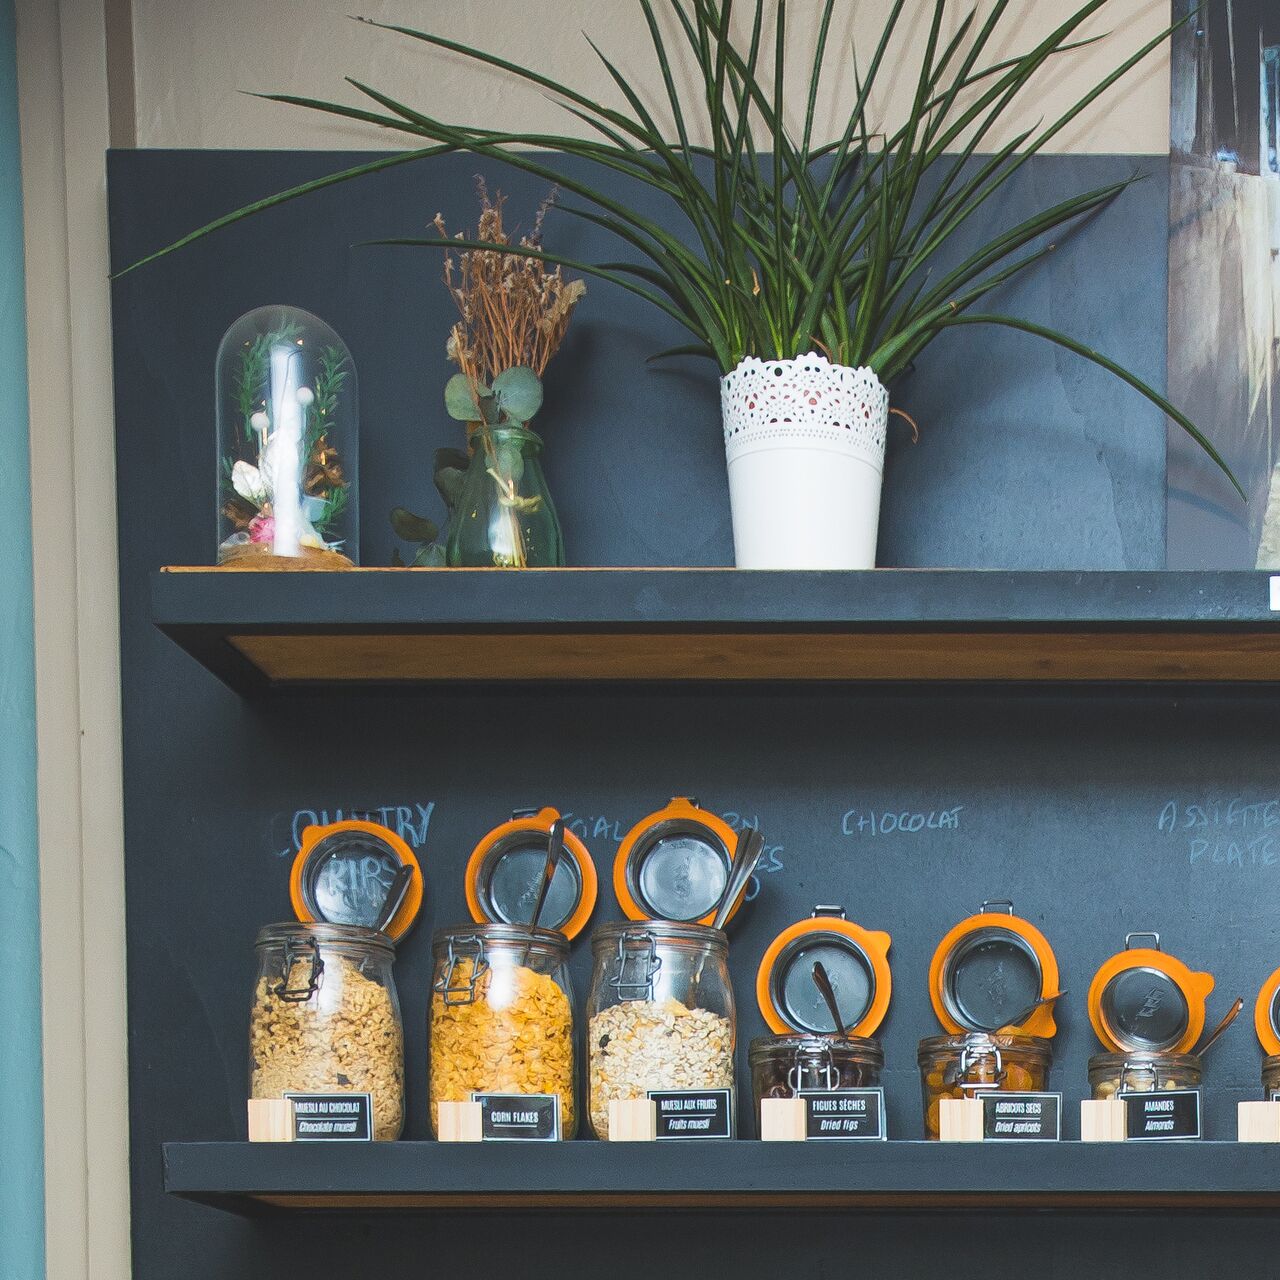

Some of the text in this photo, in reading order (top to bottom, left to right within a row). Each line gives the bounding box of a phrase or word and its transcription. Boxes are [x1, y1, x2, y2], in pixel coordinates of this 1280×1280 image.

[842, 805, 962, 836] CHOCOLAT
[295, 1102, 360, 1113] MUESLI AU CHOCOLAT
[661, 1099, 717, 1111] MUESLI AUX FRUITS
[813, 1098, 866, 1111] FIGUES SÈCHES
[995, 1102, 1041, 1114] ABRICOTS SECS
[1144, 1101, 1174, 1112] AMANDES
[491, 1111, 539, 1123] CORN FLAKES
[299, 1121, 357, 1132] Chocolate muesli
[669, 1118, 710, 1130] Fruits muesli
[821, 1120, 858, 1131] Dried figs
[995, 1122, 1041, 1134] Dried apricots
[1145, 1120, 1174, 1131] Almonds
